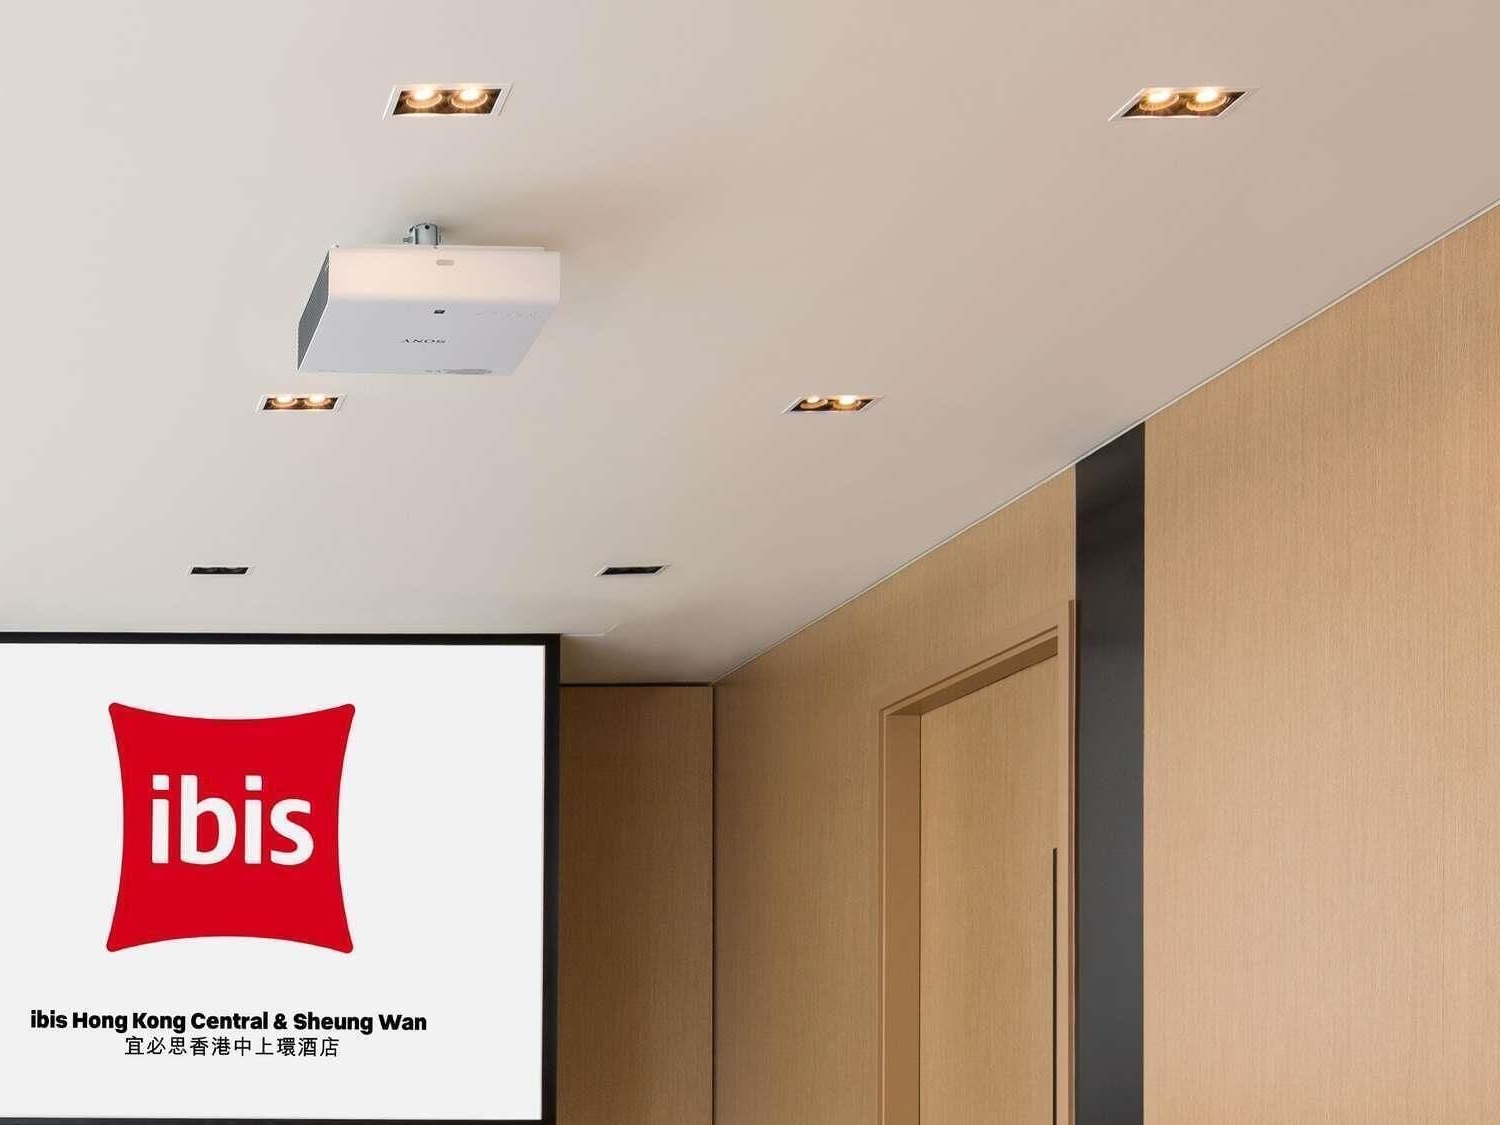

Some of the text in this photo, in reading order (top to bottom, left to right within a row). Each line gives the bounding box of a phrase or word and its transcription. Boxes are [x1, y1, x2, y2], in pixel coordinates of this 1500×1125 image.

[151, 774, 314, 866] ibis
[30, 1009, 427, 1035] ibis Hong Kong Central & Sheung Wan
[124, 1035, 340, 1057] 宜必思香港中上環酒店
